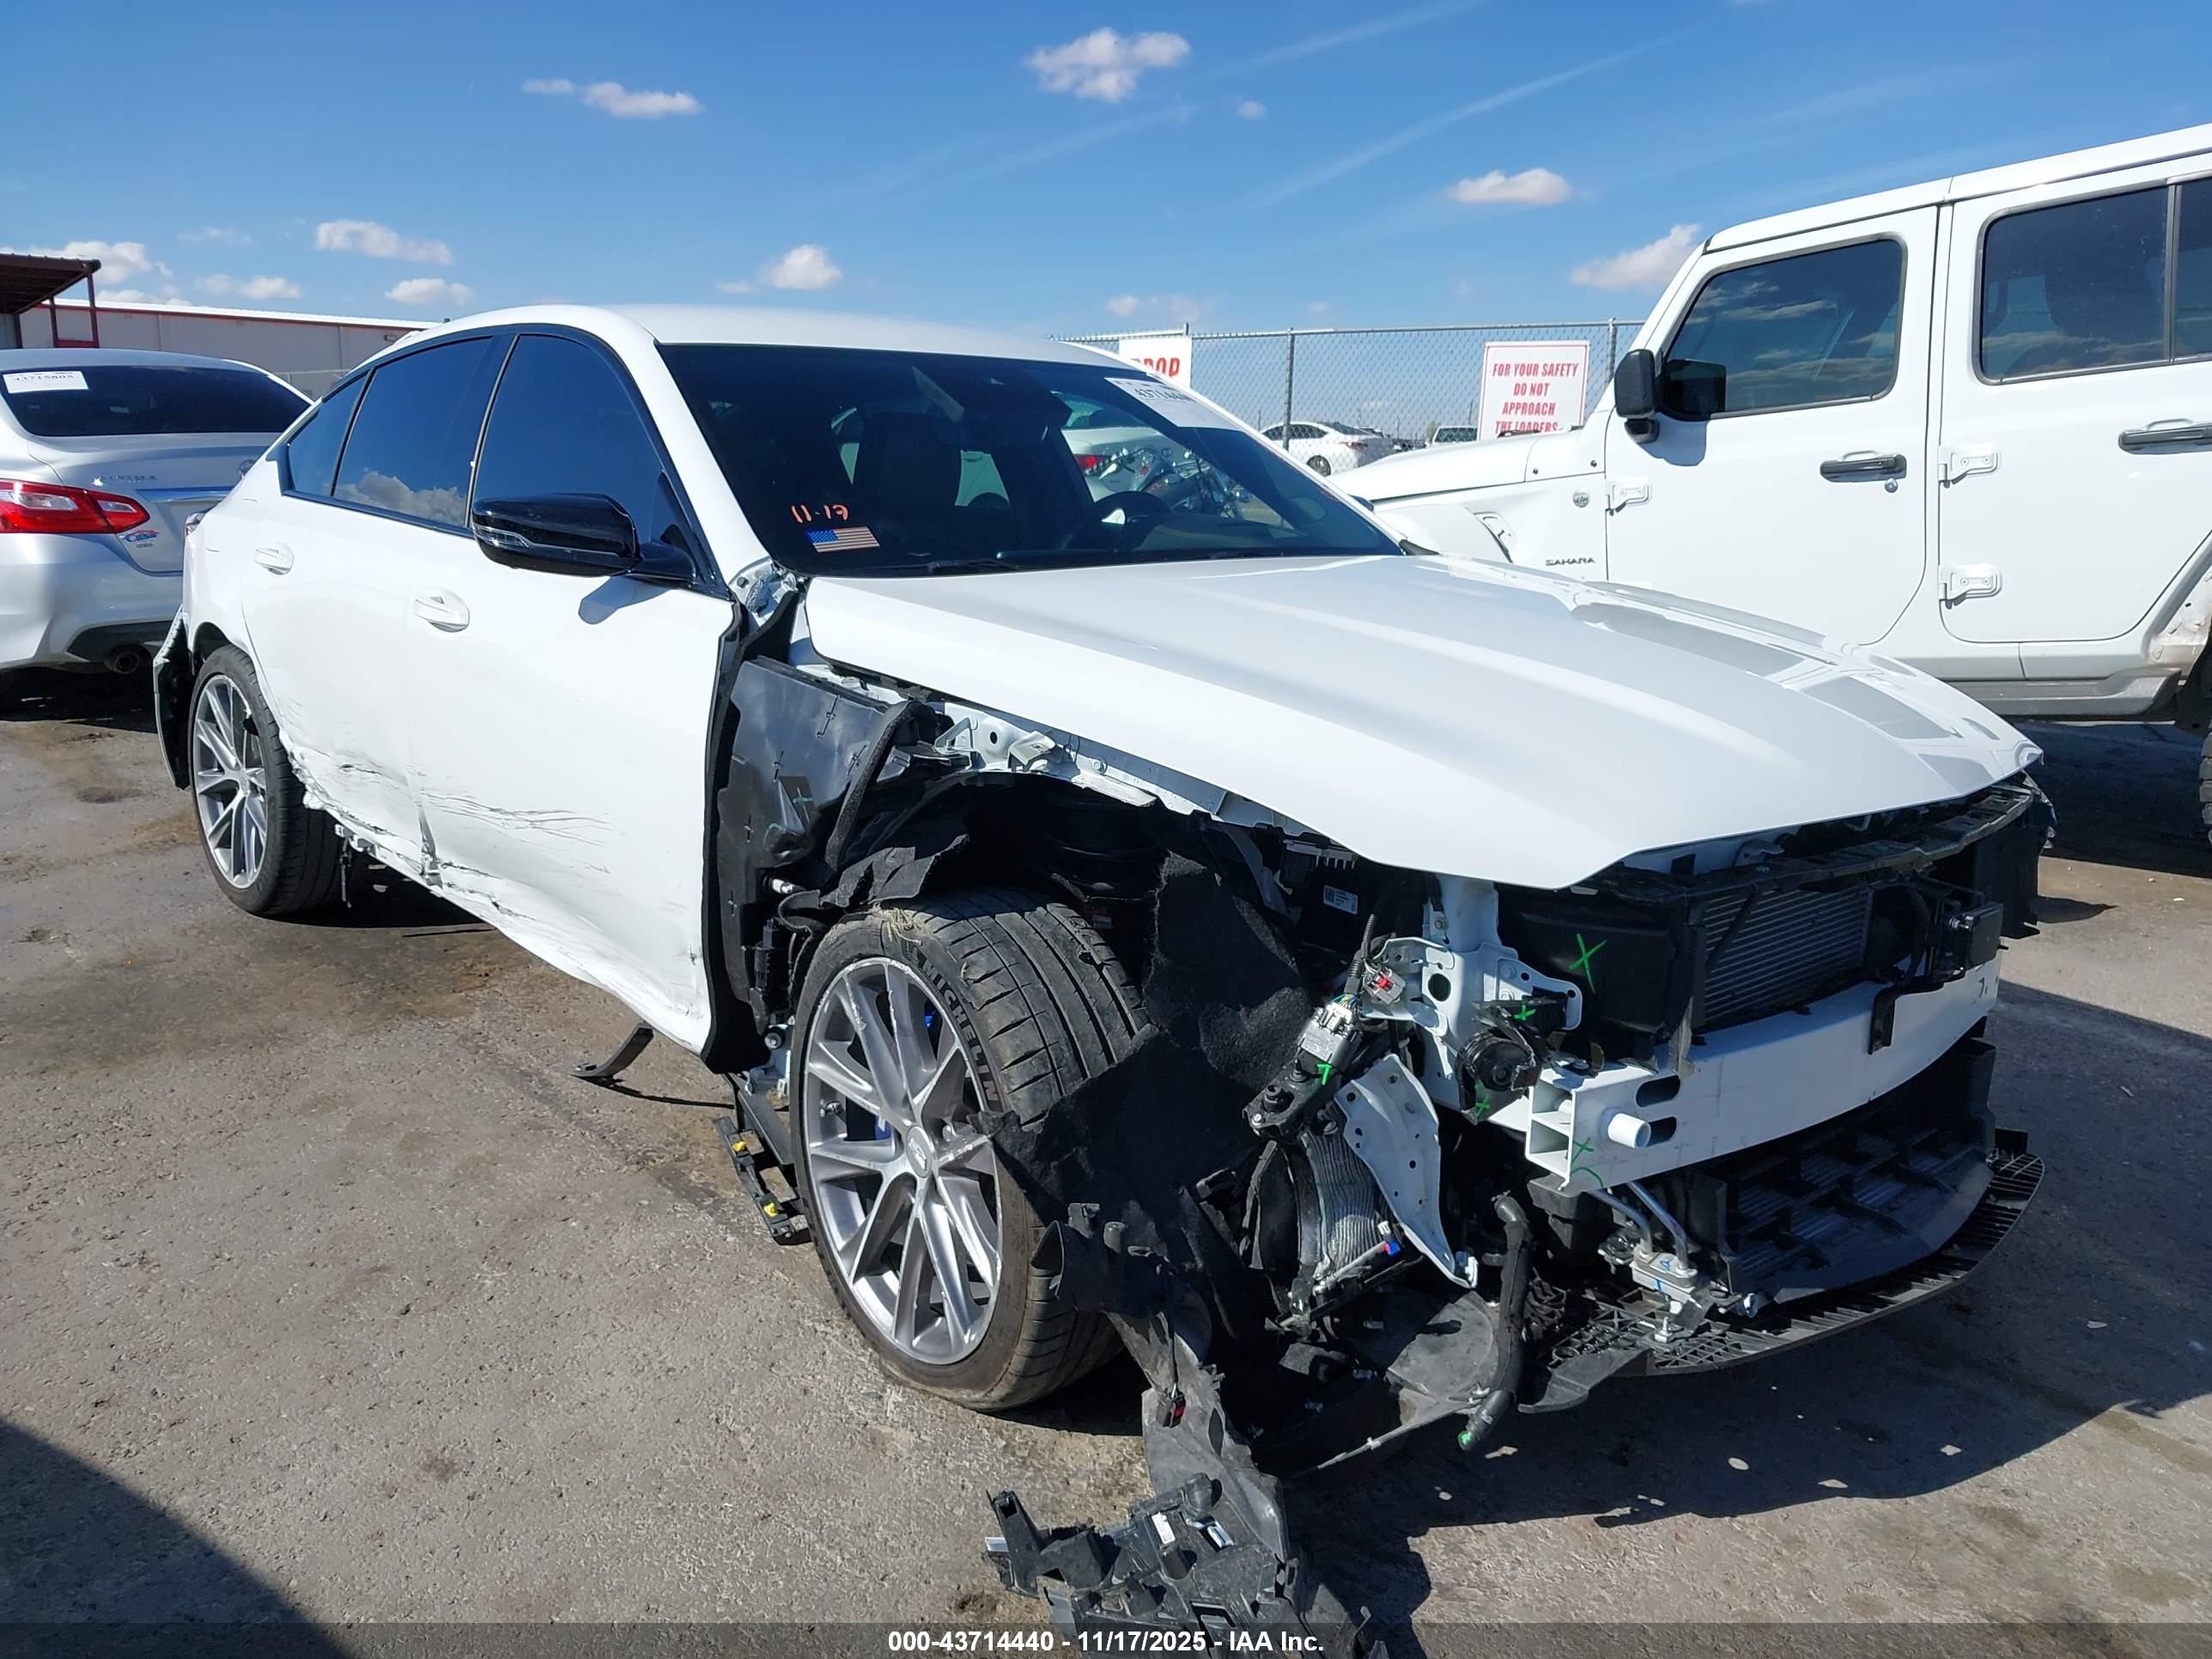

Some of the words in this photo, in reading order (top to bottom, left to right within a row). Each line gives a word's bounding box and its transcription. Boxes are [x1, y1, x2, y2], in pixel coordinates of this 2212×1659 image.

[1129, 357, 1181, 377] OP
[1492, 363, 1511, 377] FOR
[1514, 363, 1540, 377] YOUR
[1541, 362, 1579, 377] SAFETY
[1513, 383, 1528, 396] DO
[1529, 383, 1550, 396] NOT
[1502, 402, 1556, 416] APPROACH
[1495, 421, 1513, 433] THE
[1545, 557, 1595, 566] SAHARA
[922, 959, 999, 1101] MICHELIN
